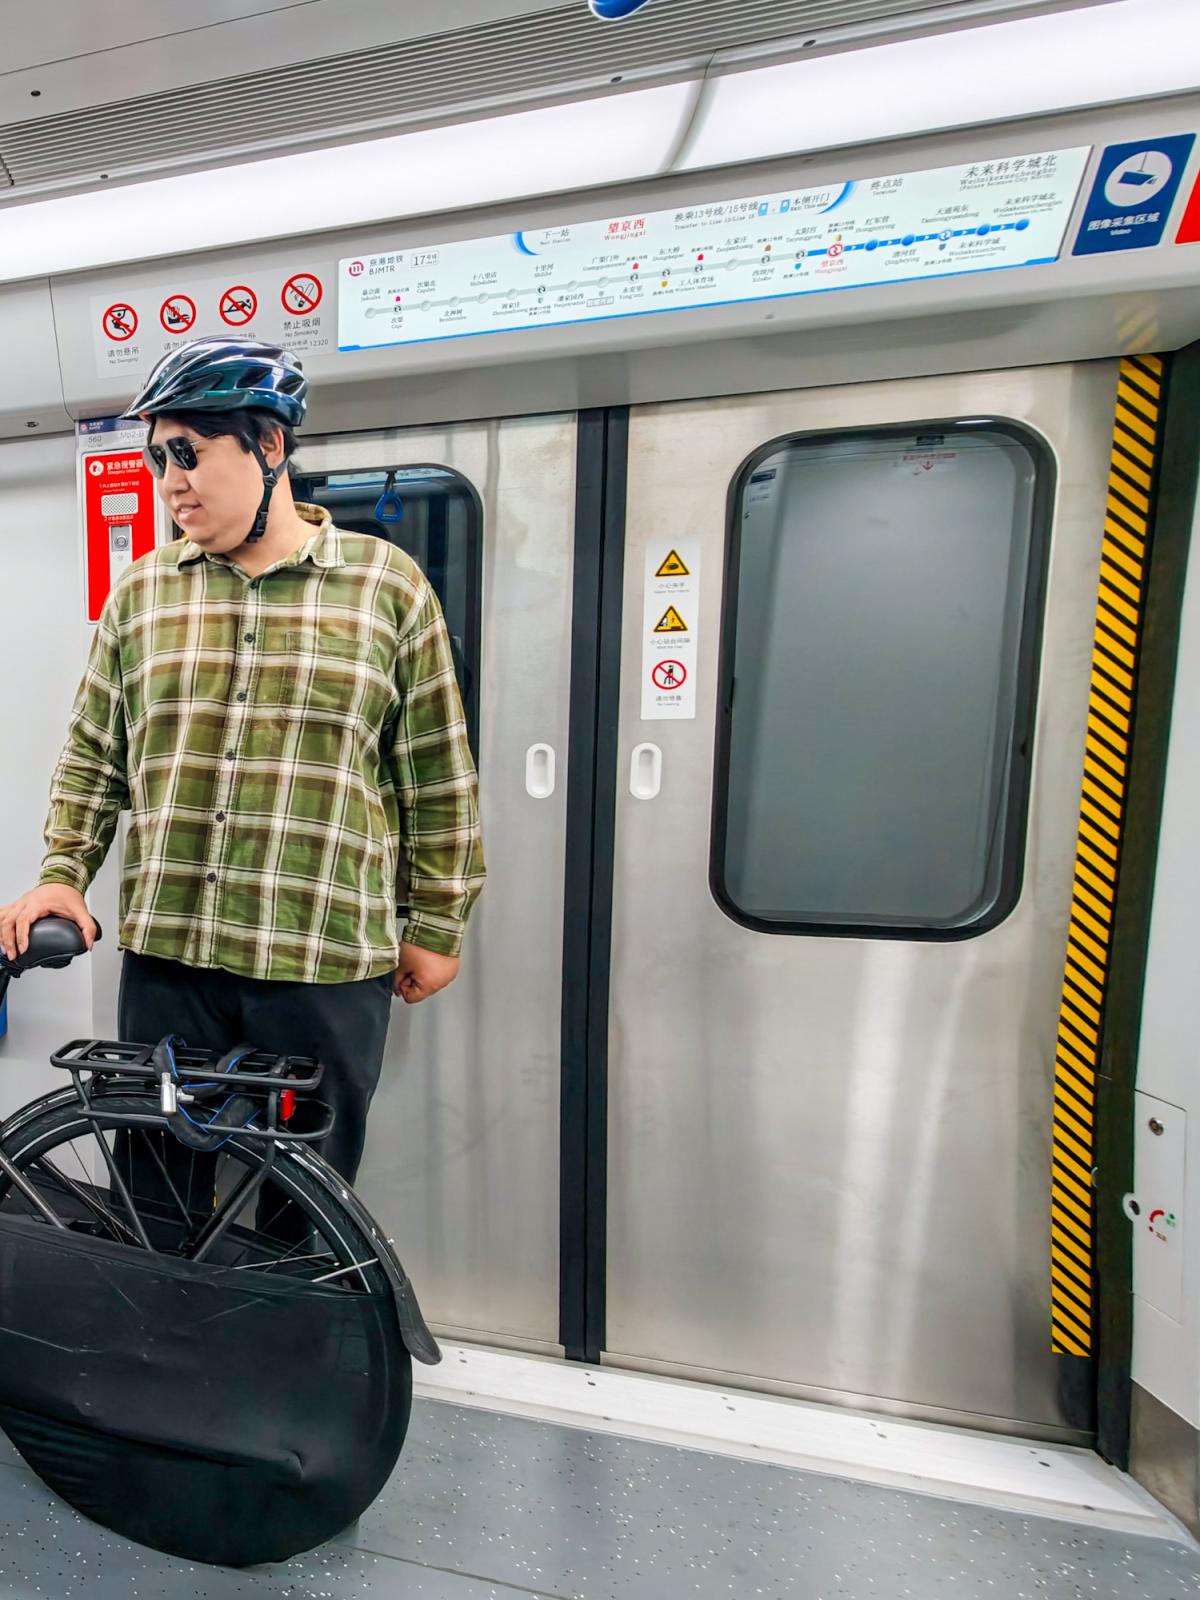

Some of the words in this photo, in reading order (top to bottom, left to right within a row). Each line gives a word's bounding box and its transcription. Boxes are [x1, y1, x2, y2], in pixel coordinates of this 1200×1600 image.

[966, 154, 1057, 178] 未来科学城北
[608, 217, 645, 234] 望京西
[369, 265, 396, 276] BJMTR
[283, 317, 321, 331] 禁止吸烟
